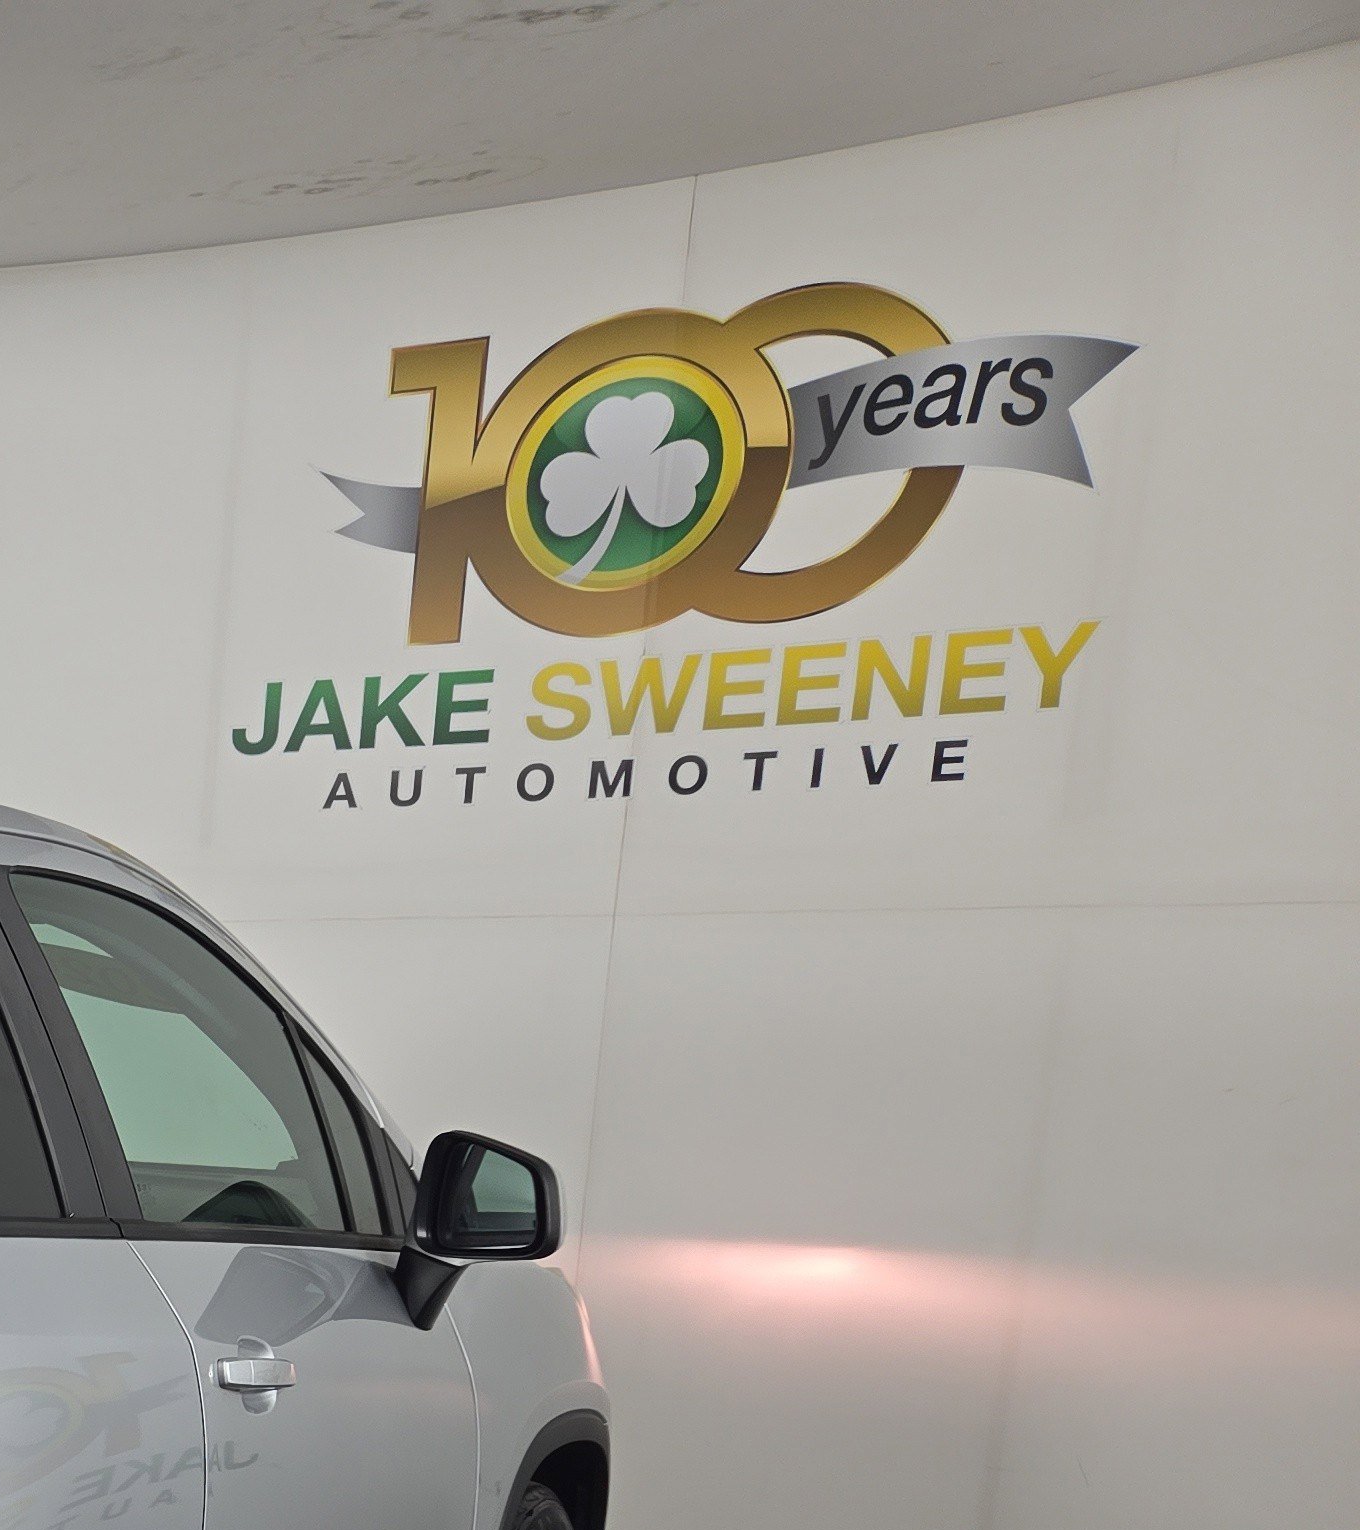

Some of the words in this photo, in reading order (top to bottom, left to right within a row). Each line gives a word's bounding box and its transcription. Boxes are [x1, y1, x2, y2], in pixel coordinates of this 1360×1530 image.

[807, 355, 1053, 470] years
[231, 668, 495, 756] JAKE
[525, 620, 1100, 742] SWEENEY
[322, 738, 969, 809] AUTOMOTIVE
